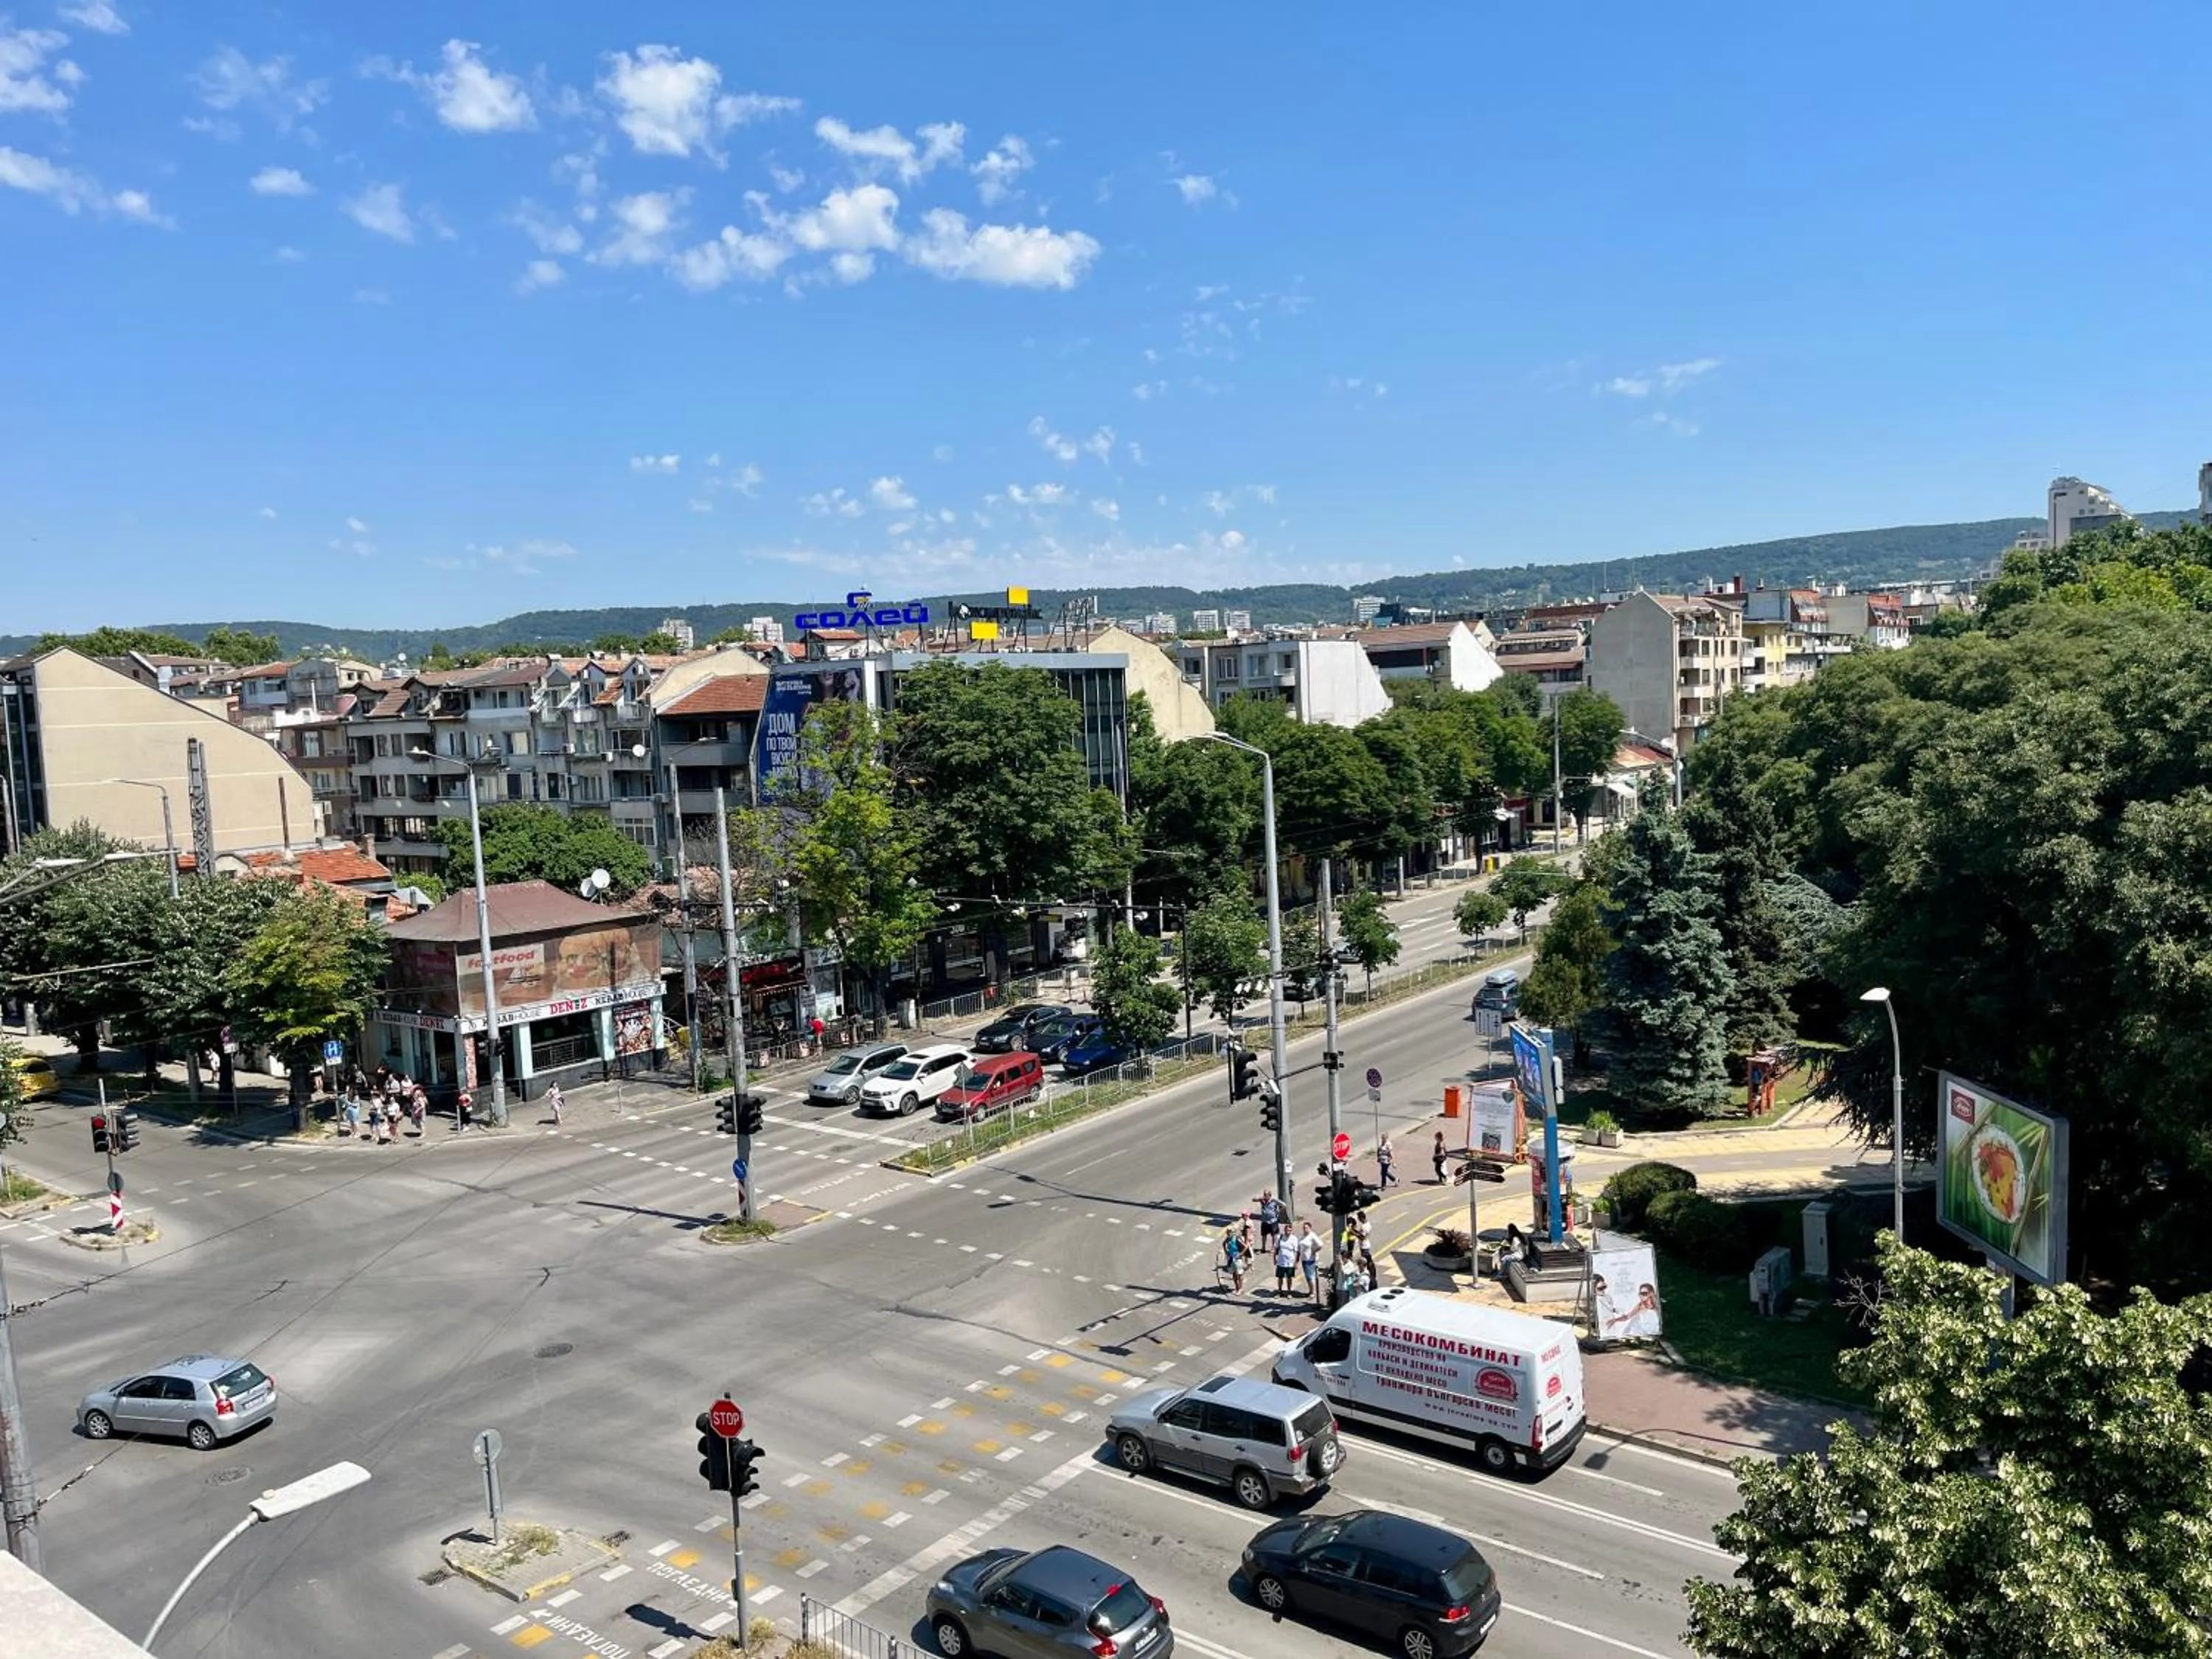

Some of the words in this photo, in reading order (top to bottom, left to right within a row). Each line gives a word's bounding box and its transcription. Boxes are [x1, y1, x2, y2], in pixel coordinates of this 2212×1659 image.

[768, 713, 795, 736] ДОМ
[766, 737, 776, 751] ПО
[468, 950, 535, 968] fatfood
[482, 1013, 514, 1027] KBAB
[1335, 1140, 1349, 1152] STOP
[1362, 1321, 1522, 1367] МЕСОКОМБИНАТ
[713, 1411, 740, 1426] STOP
[646, 1561, 733, 1604] ПОГЛЕДНИ
